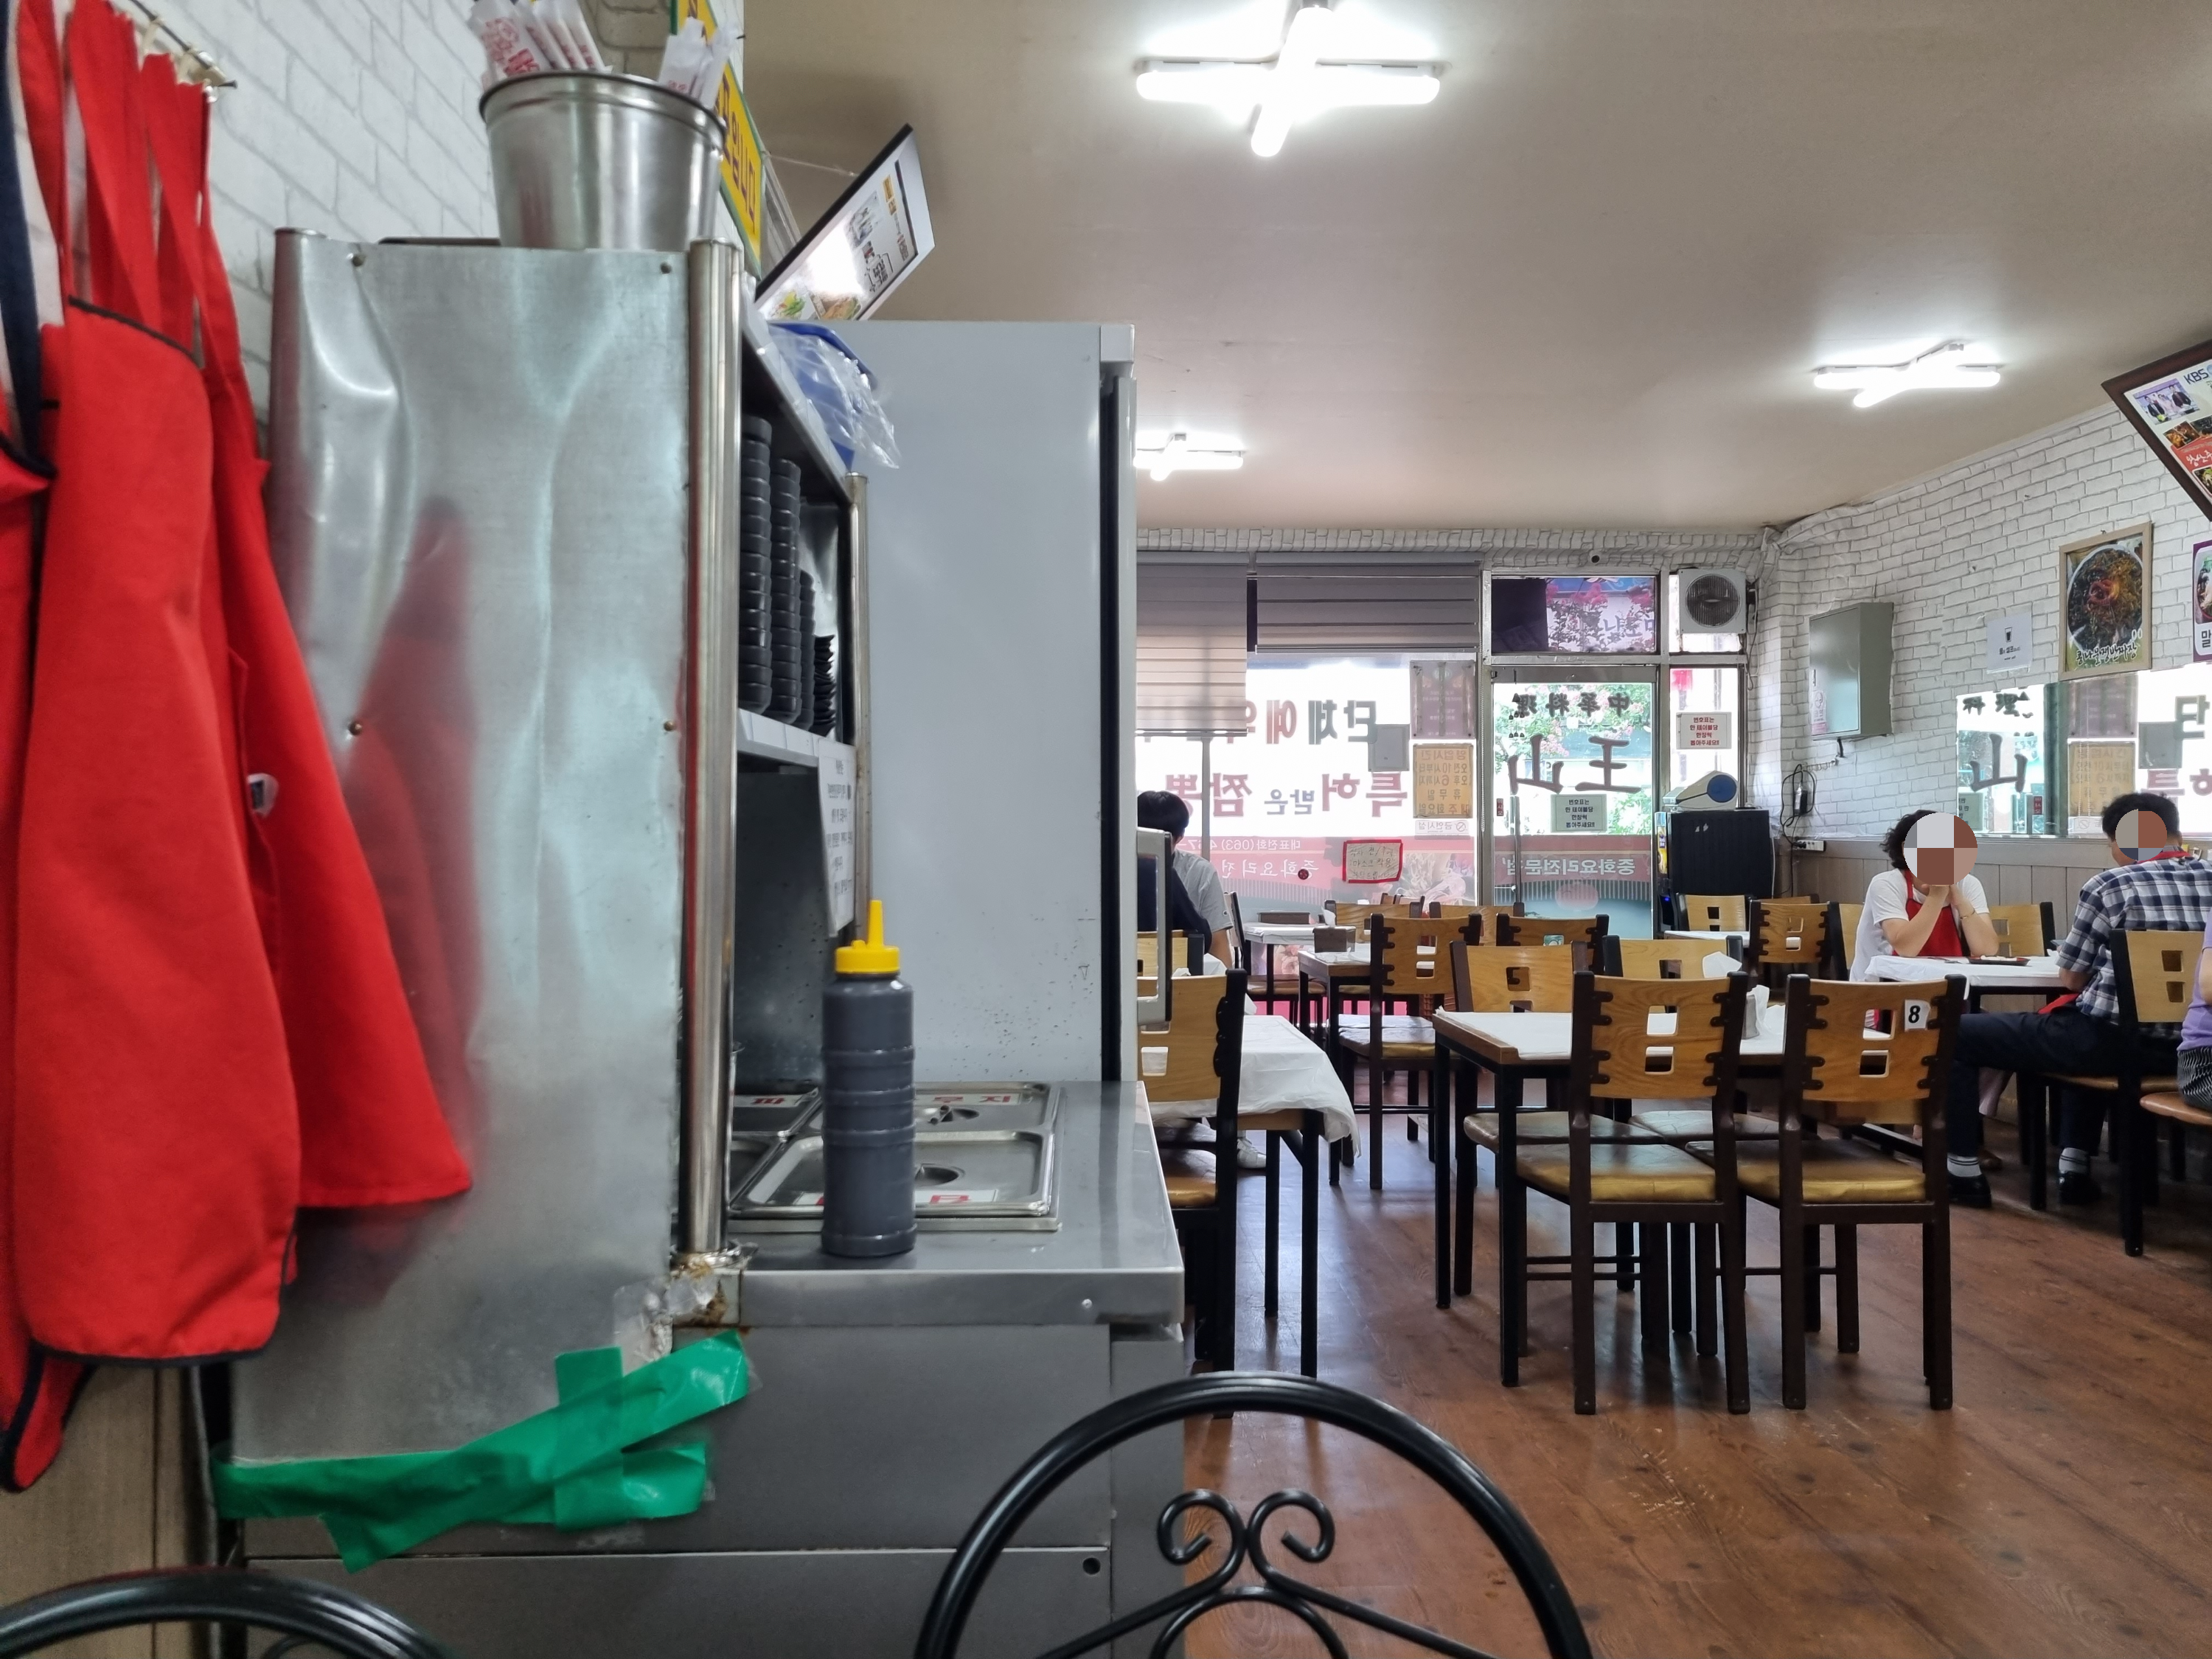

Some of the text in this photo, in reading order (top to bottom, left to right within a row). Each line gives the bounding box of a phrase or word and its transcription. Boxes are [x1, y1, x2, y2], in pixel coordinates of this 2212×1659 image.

[2183, 368, 2209, 385] KBS
[2076, 641, 2138, 667] 콩나물쟁반짜장
[1907, 1004, 1921, 1025] 8
[914, 1095, 1013, 1104] 무지
